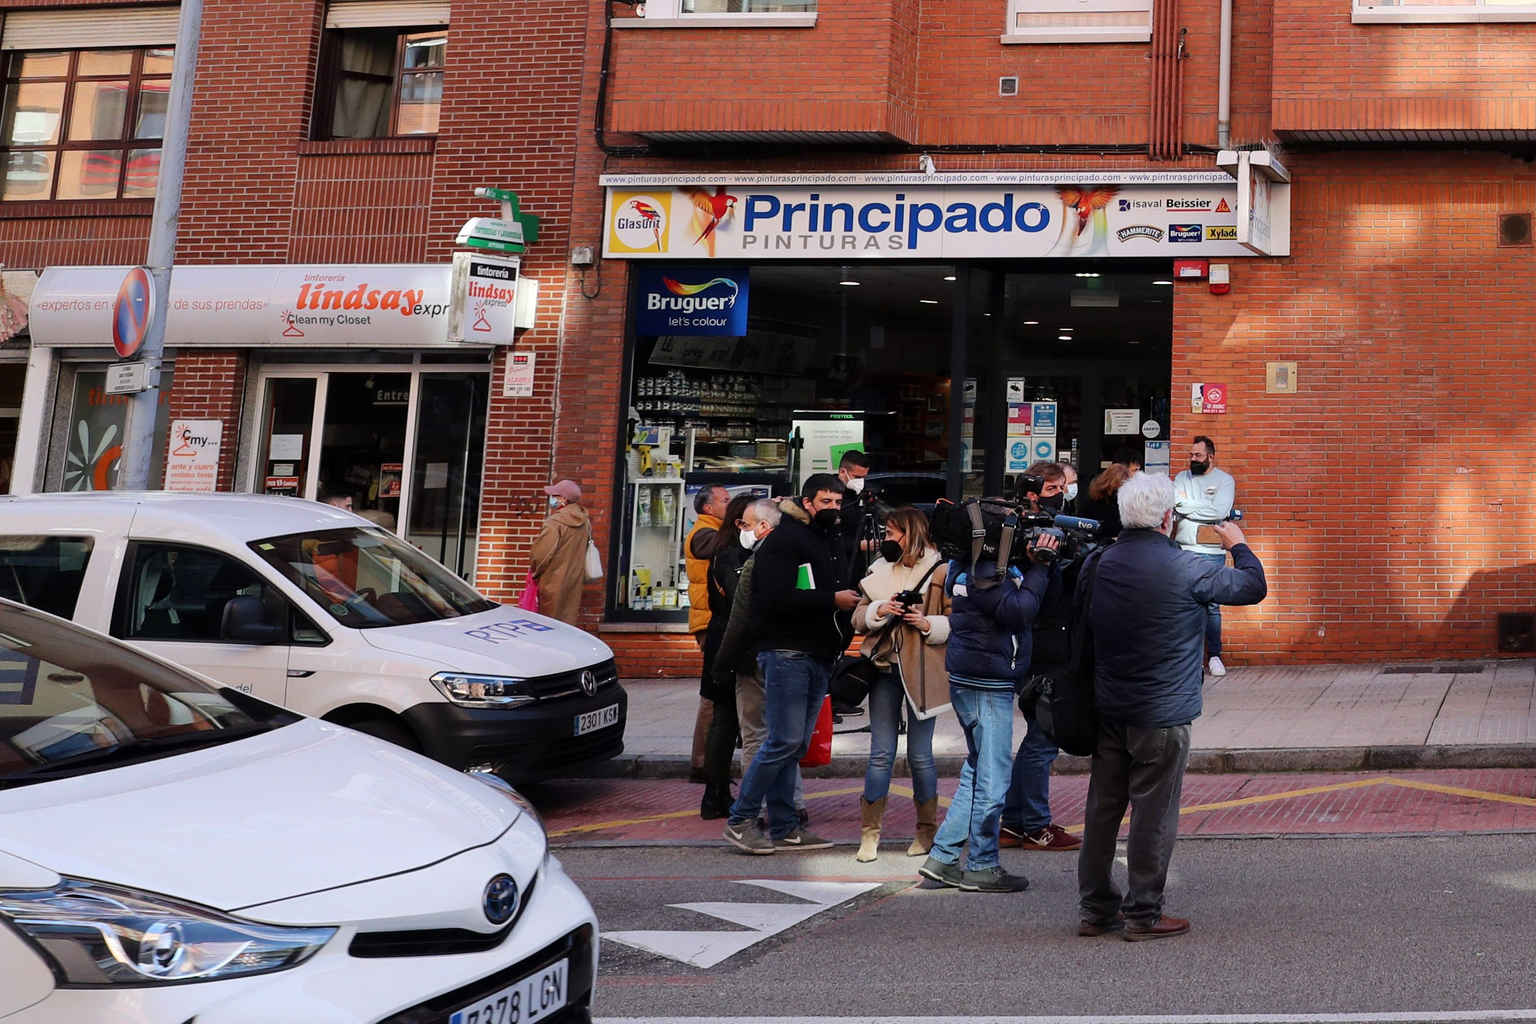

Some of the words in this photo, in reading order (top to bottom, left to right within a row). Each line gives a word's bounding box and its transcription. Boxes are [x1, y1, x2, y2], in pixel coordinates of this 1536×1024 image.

[605, 175, 727, 184] www.pinturasprincipado.com
[734, 174, 857, 184] www.pinturasprincipado.com
[864, 173, 988, 184] www.pinturasprincipado.com
[996, 172, 1121, 183] www.pinturasprincipado.com
[1132, 199, 1162, 208] isaval
[1166, 198, 1212, 208] Beissier
[617, 217, 661, 230] Glasurit
[743, 193, 1050, 250] Principado
[1119, 225, 1161, 239] HAMMERITE
[1170, 230, 1199, 238] Bruguer
[742, 235, 904, 251] PINTURAS
[304, 273, 346, 282] tintorería
[477, 265, 509, 278] tintorería
[468, 281, 515, 303] lindsay
[94, 300, 109, 310] en
[174, 298, 189, 310] de
[191, 300, 212, 310] sus
[296, 283, 424, 316] lindsay
[484, 298, 508, 307] express
[647, 293, 729, 314] Bruguer
[287, 314, 318, 325] Clean
[319, 316, 335, 326] my
[336, 314, 371, 325] Closet
[668, 317, 690, 326] let's
[692, 317, 728, 326] colour
[1077, 520, 1093, 529] tve
[982, 543, 995, 553] tve
[581, 713, 601, 731] 2301
[527, 966, 563, 1018] LGN
